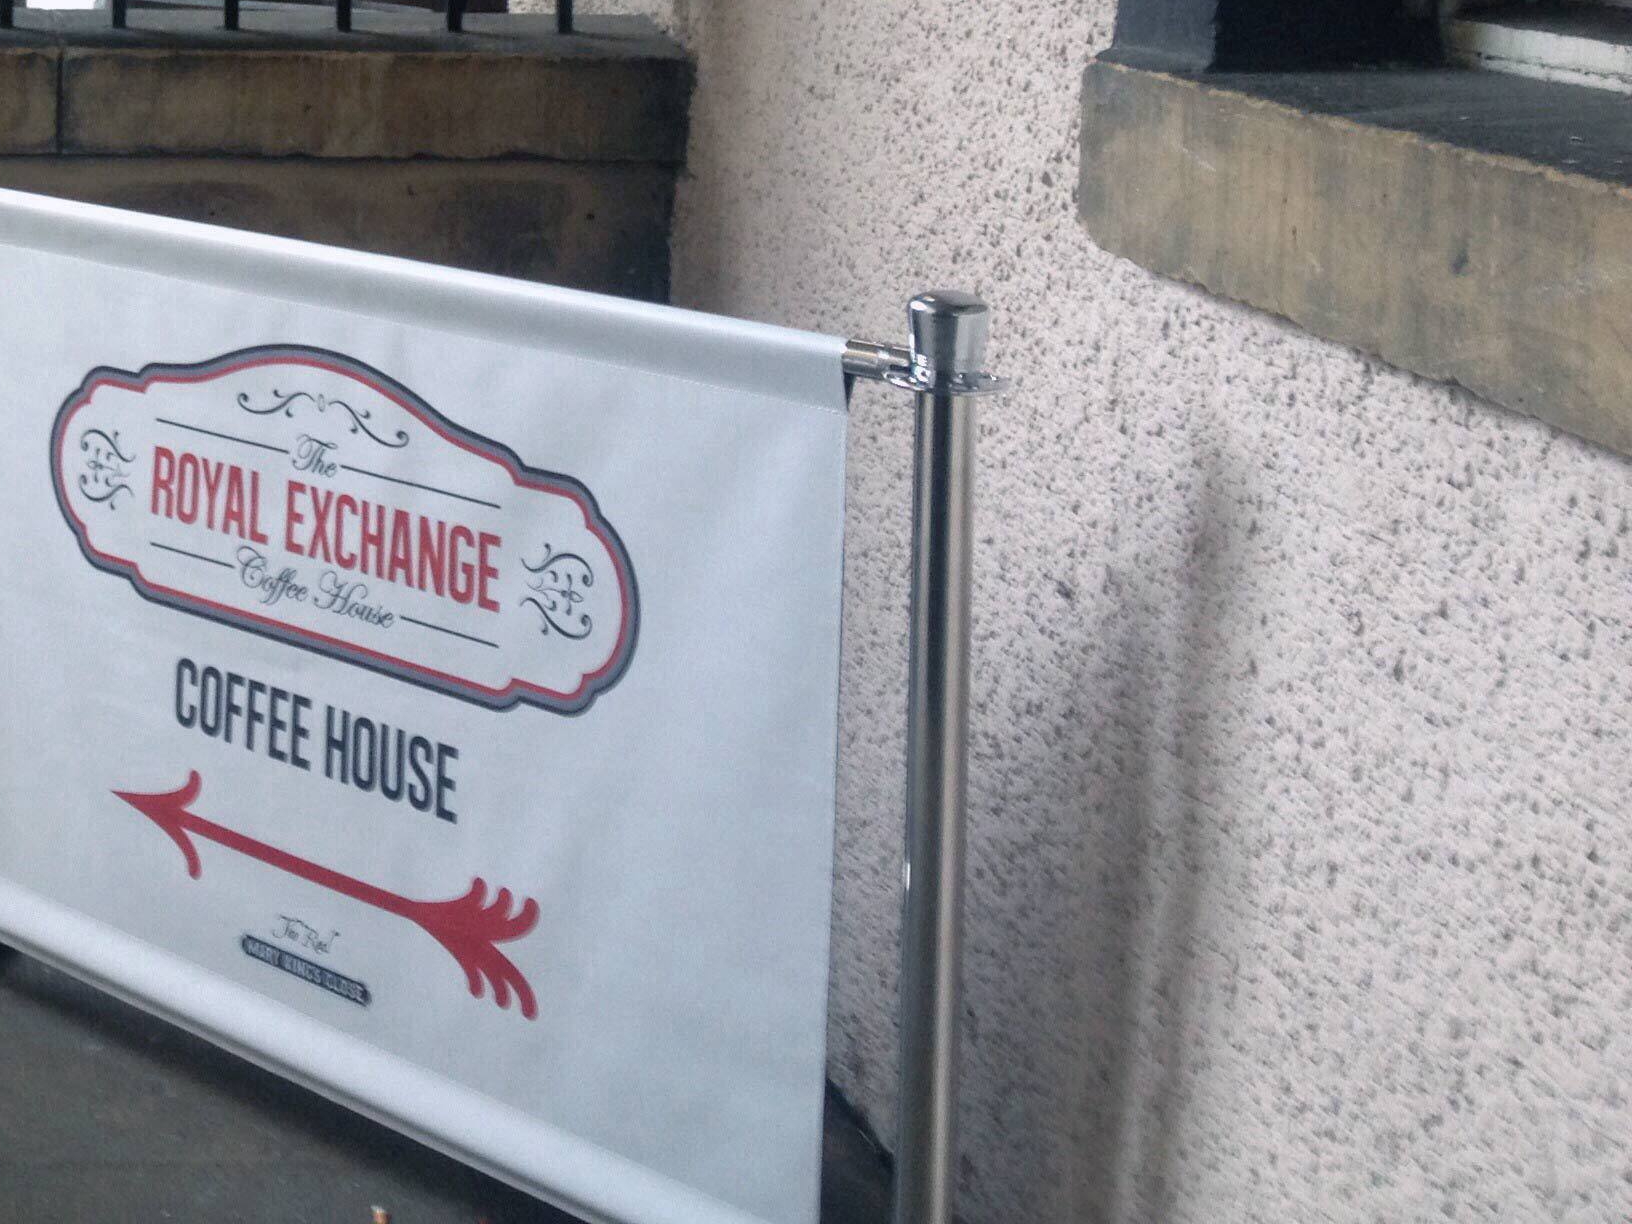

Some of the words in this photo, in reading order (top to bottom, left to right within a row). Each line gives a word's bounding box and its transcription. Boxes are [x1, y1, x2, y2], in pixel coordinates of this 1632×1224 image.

[290, 432, 339, 479] The
[150, 445, 269, 546] ROYAL
[283, 478, 503, 614] EXCHANGE
[235, 544, 310, 606] Coffee
[311, 569, 396, 629] House
[174, 657, 313, 772] COFFEE
[324, 703, 460, 825] HOUSE
